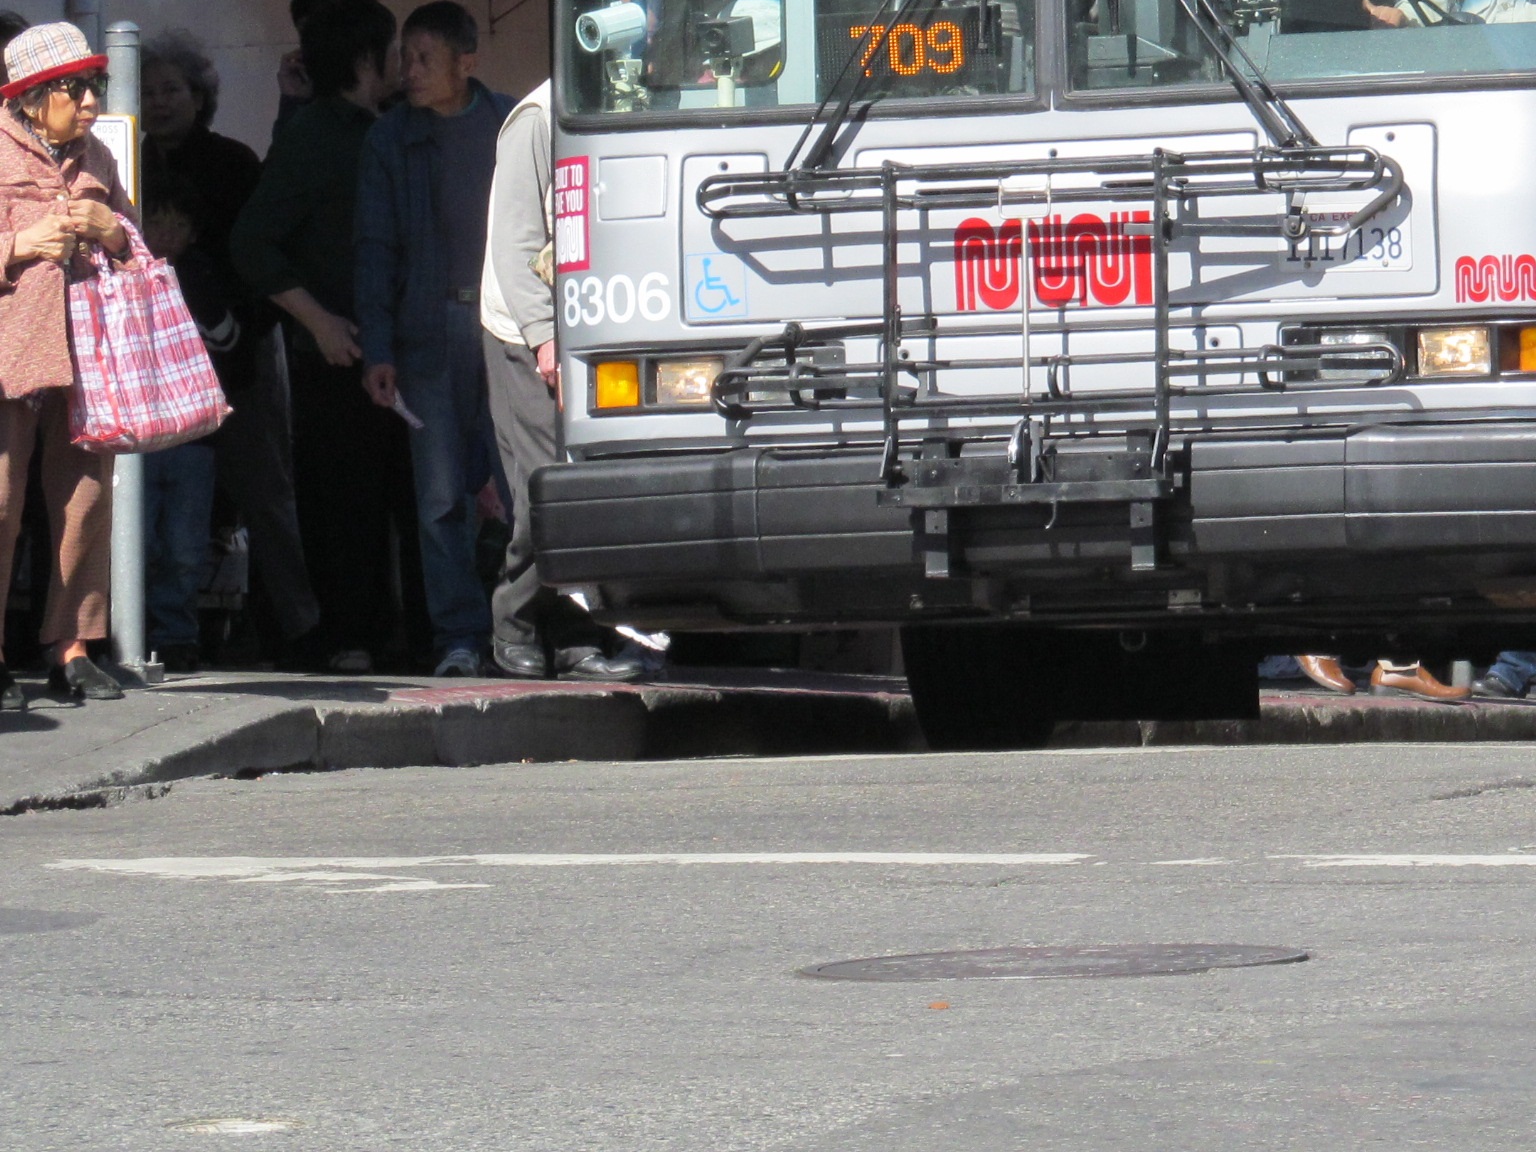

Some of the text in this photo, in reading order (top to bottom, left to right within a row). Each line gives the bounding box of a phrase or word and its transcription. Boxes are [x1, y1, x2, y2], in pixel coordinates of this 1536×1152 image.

[850, 21, 964, 77] 709
[570, 164, 583, 187] TO
[565, 188, 583, 213] YOU
[1310, 213, 1325, 222] CA
[564, 271, 671, 328] 8306
